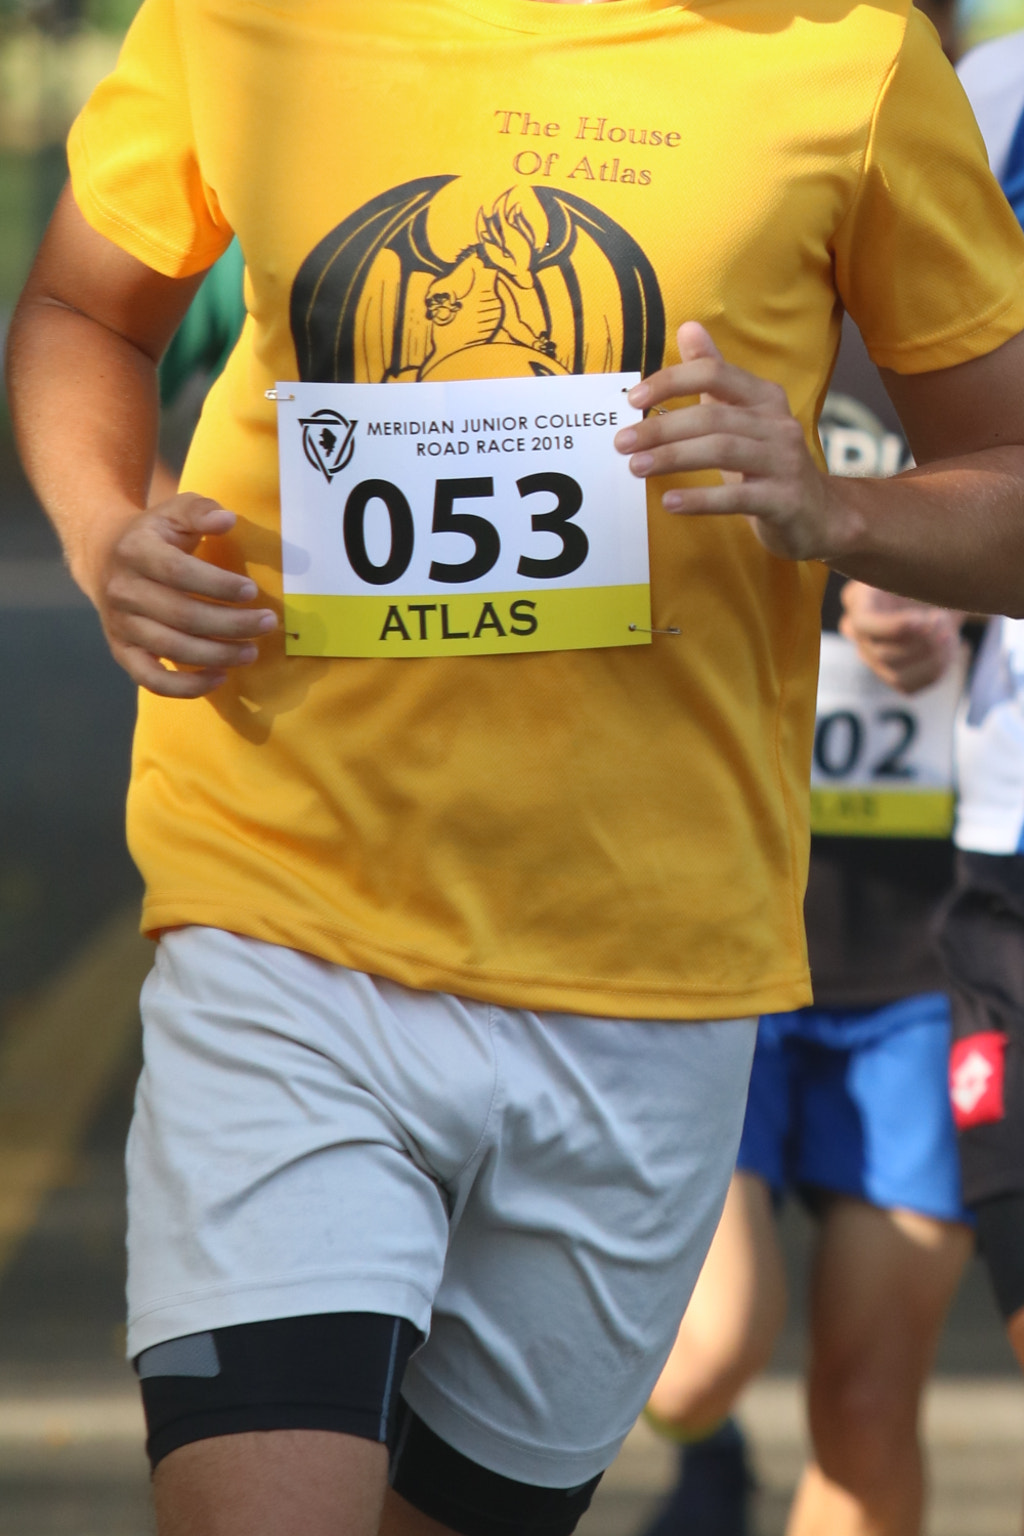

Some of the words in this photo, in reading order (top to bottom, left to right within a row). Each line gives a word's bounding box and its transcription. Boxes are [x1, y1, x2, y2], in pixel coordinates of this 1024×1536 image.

[494, 110, 560, 137] The
[575, 116, 681, 147] House
[512, 150, 560, 176] Of
[567, 155, 652, 186] Atlas
[367, 420, 454, 436] MERIDIAN
[461, 416, 528, 433] JUNIOR
[534, 412, 618, 429] COLLEGE
[416, 441, 470, 457] ROAD
[477, 438, 526, 454] RACE
[531, 435, 574, 451] 2018
[343, 472, 589, 585] 053
[379, 600, 538, 641] ATLAS
[814, 708, 919, 779] 02
